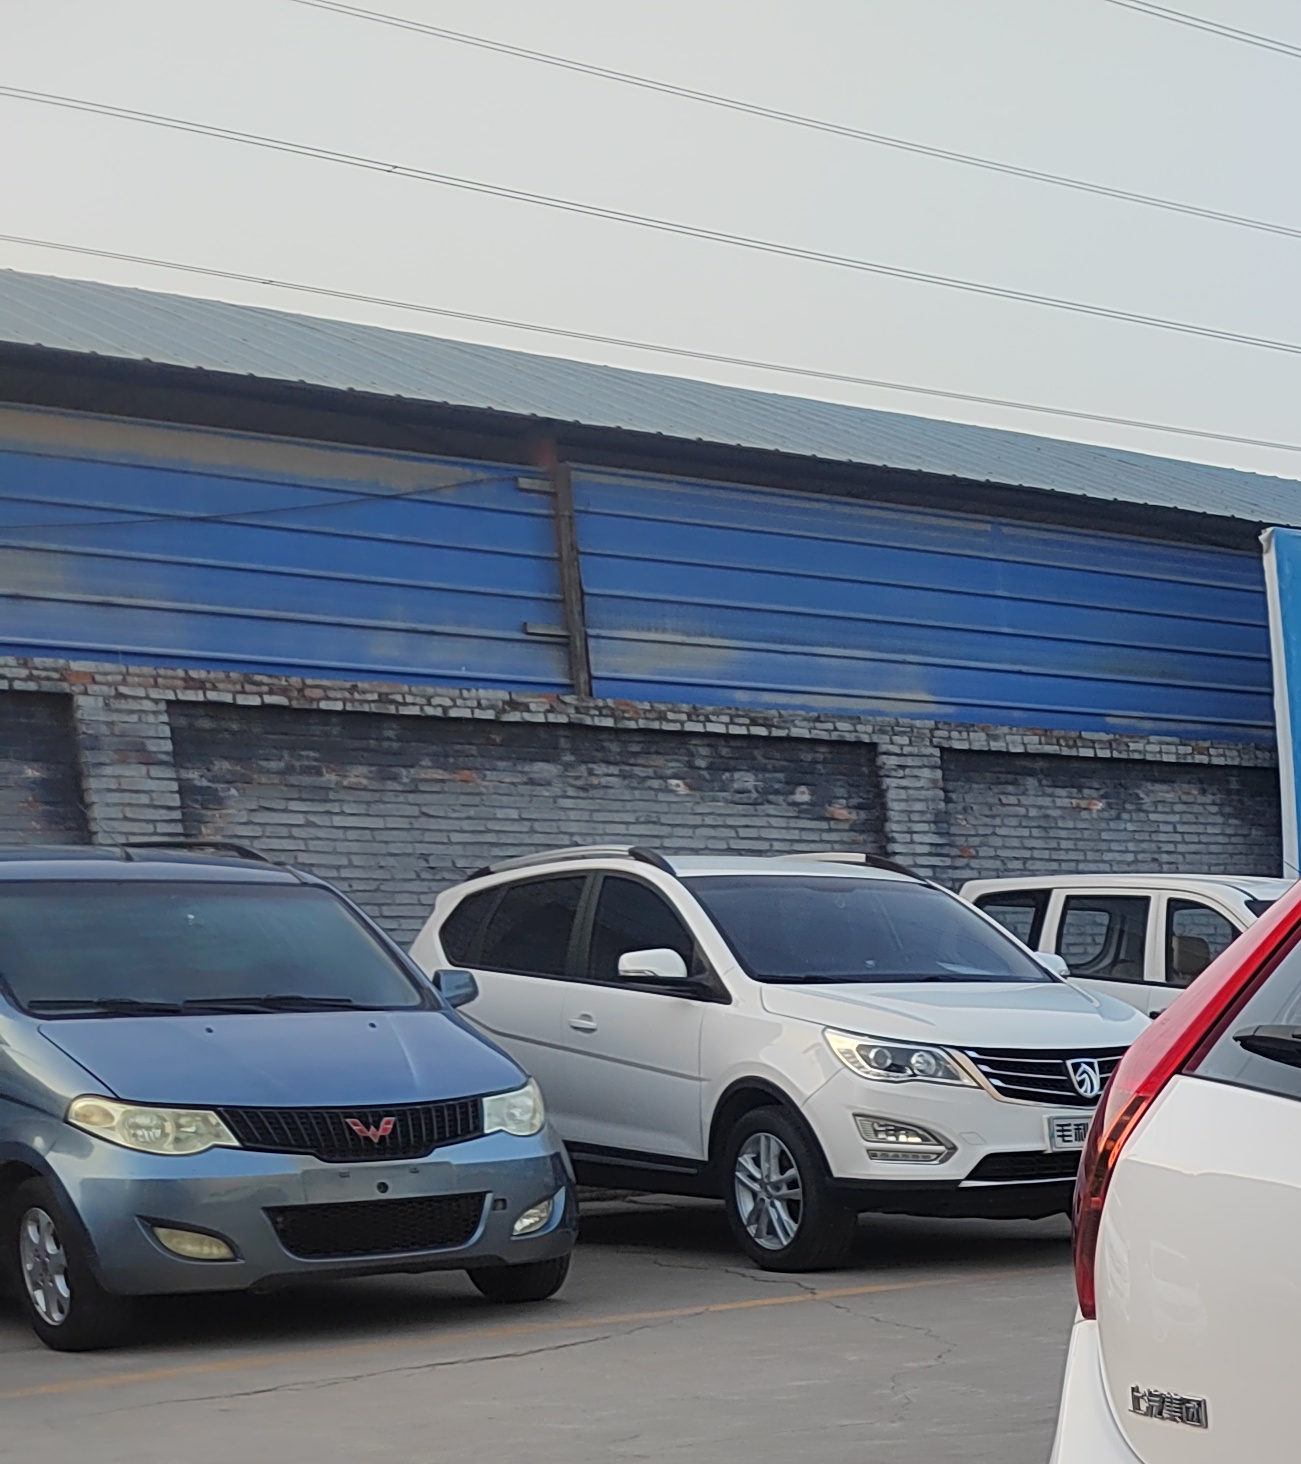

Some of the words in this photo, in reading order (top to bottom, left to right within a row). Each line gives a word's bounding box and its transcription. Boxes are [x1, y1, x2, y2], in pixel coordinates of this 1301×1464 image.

[1056, 1123, 1089, 1142] 毛利
[1128, 1385, 1209, 1429] 上汽集团
